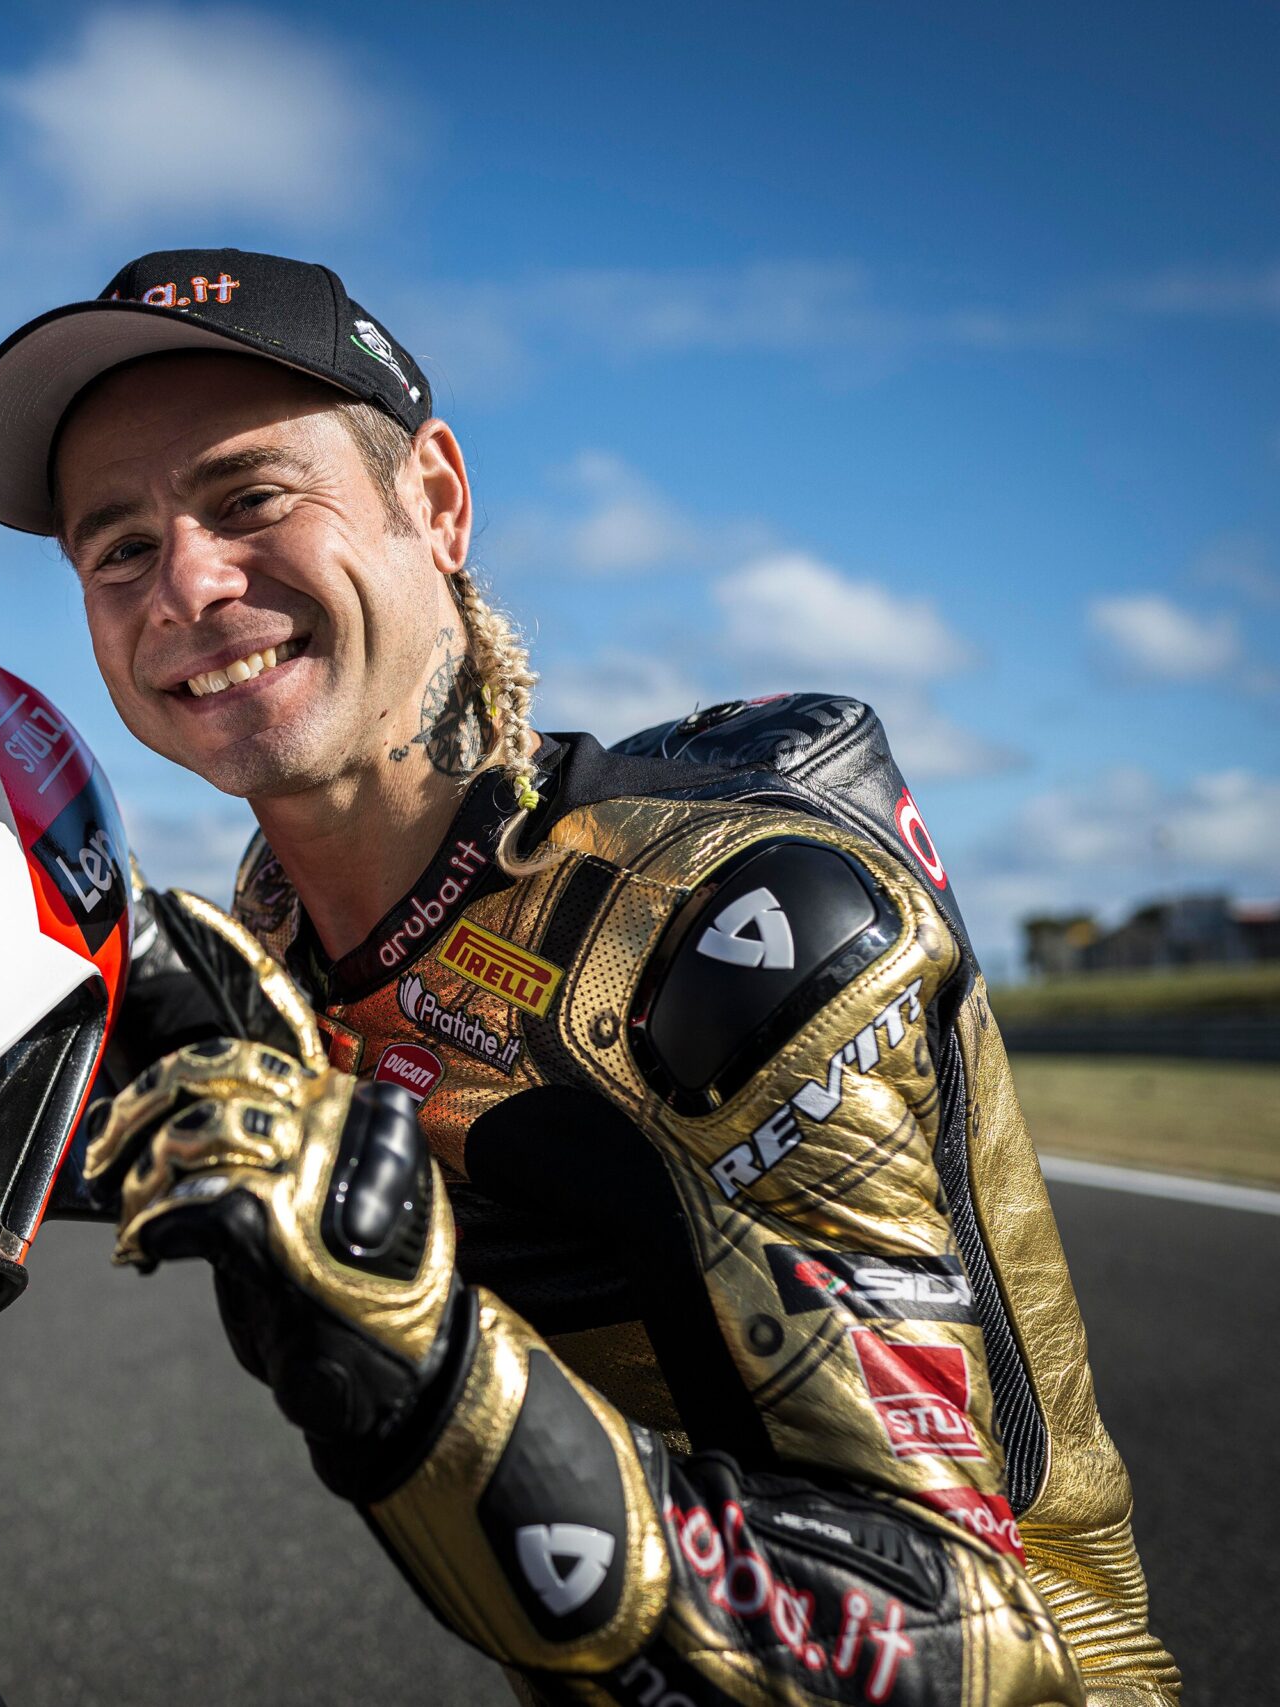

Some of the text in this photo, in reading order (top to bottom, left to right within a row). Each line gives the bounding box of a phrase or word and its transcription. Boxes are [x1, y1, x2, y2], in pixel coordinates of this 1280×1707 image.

[4, 706, 66, 774] STULZ
[378, 840, 487, 967] aruba.it
[444, 925, 552, 1008] PIRELLI
[419, 993, 521, 1065] Pratiche.it
[384, 1053, 436, 1088] DUCATI
